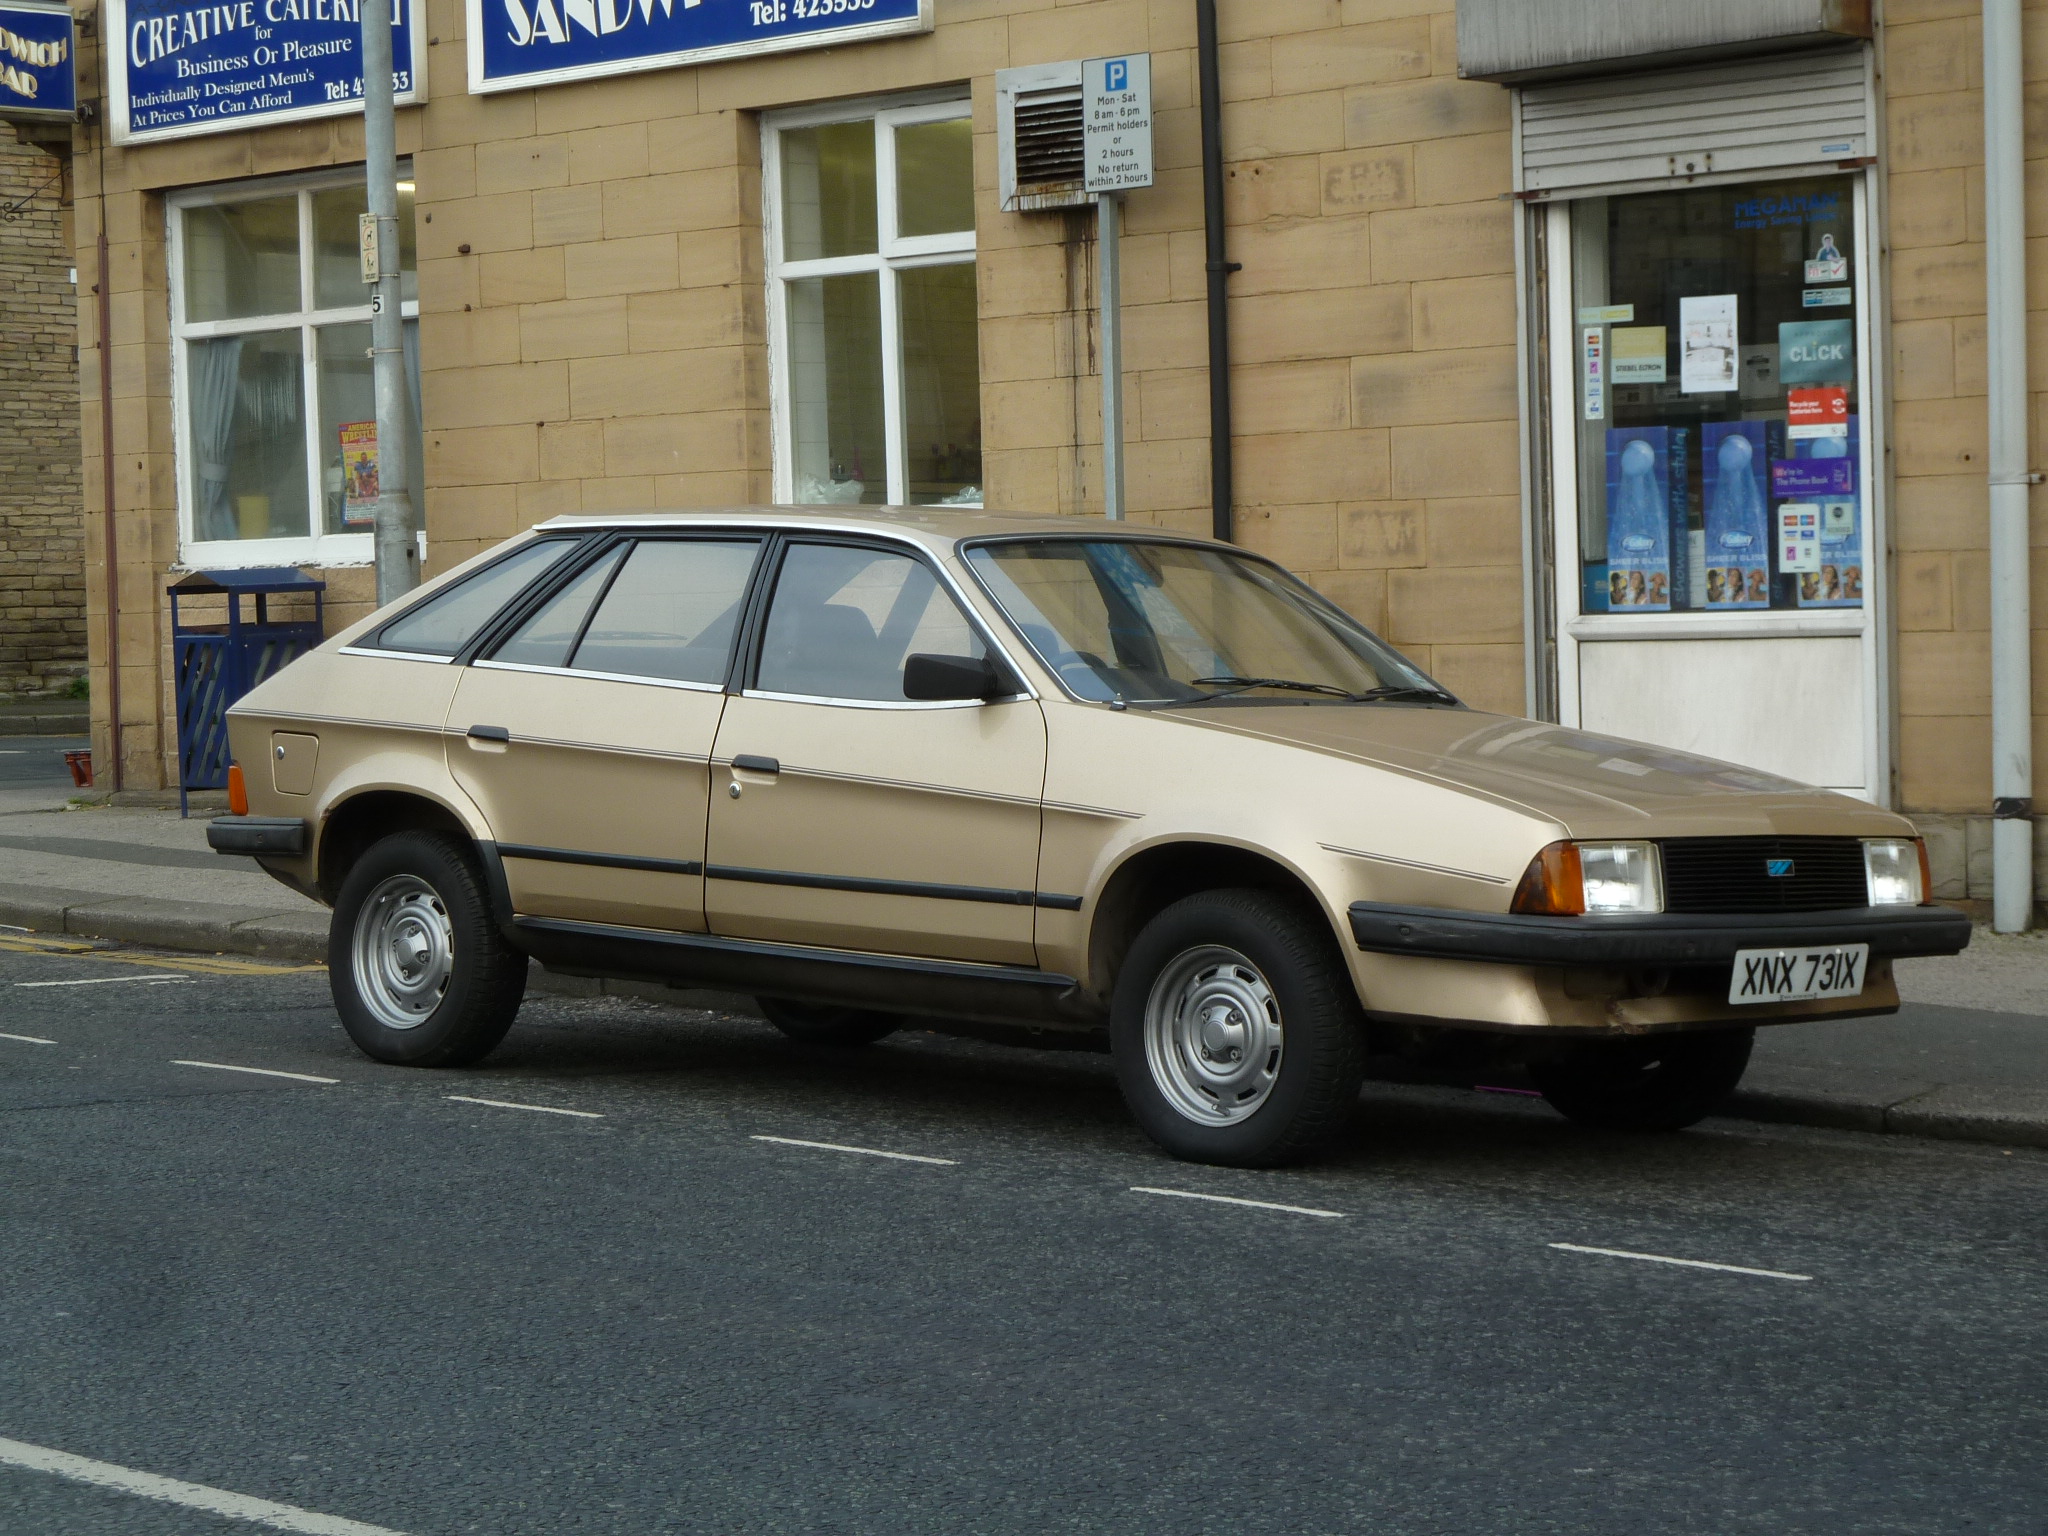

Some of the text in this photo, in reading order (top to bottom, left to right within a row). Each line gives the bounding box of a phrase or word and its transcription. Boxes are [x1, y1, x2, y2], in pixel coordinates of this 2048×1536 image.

[750, 0, 786, 25] Tel:
[132, 2, 255, 68] CREATIVE
[255, 25, 273, 40] for
[176, 38, 352, 78] Business Or Pleasure
[1110, 64, 1125, 89] P
[131, 68, 315, 108] Individually Designed Menu's
[324, 80, 349, 100] Tel:
[1097, 96, 1116, 106] Mon
[1121, 93, 1136, 103] Sat
[132, 91, 293, 127] At Prices You Can Afford
[1094, 110, 1100, 119] 8
[1101, 111, 1114, 119] am
[1120, 107, 1126, 117] 6
[1127, 107, 1140, 118] pm
[1087, 119, 1149, 134] Permit holders
[1113, 136, 1122, 145] or
[1101, 148, 1134, 159] 2 hours
[1098, 162, 1139, 174] No return
[1087, 173, 1148, 187] within 2 hours
[1734, 193, 1837, 218] MEGAMAN
[372, 296, 381, 313] 5
[1740, 955, 1797, 996] XNX
